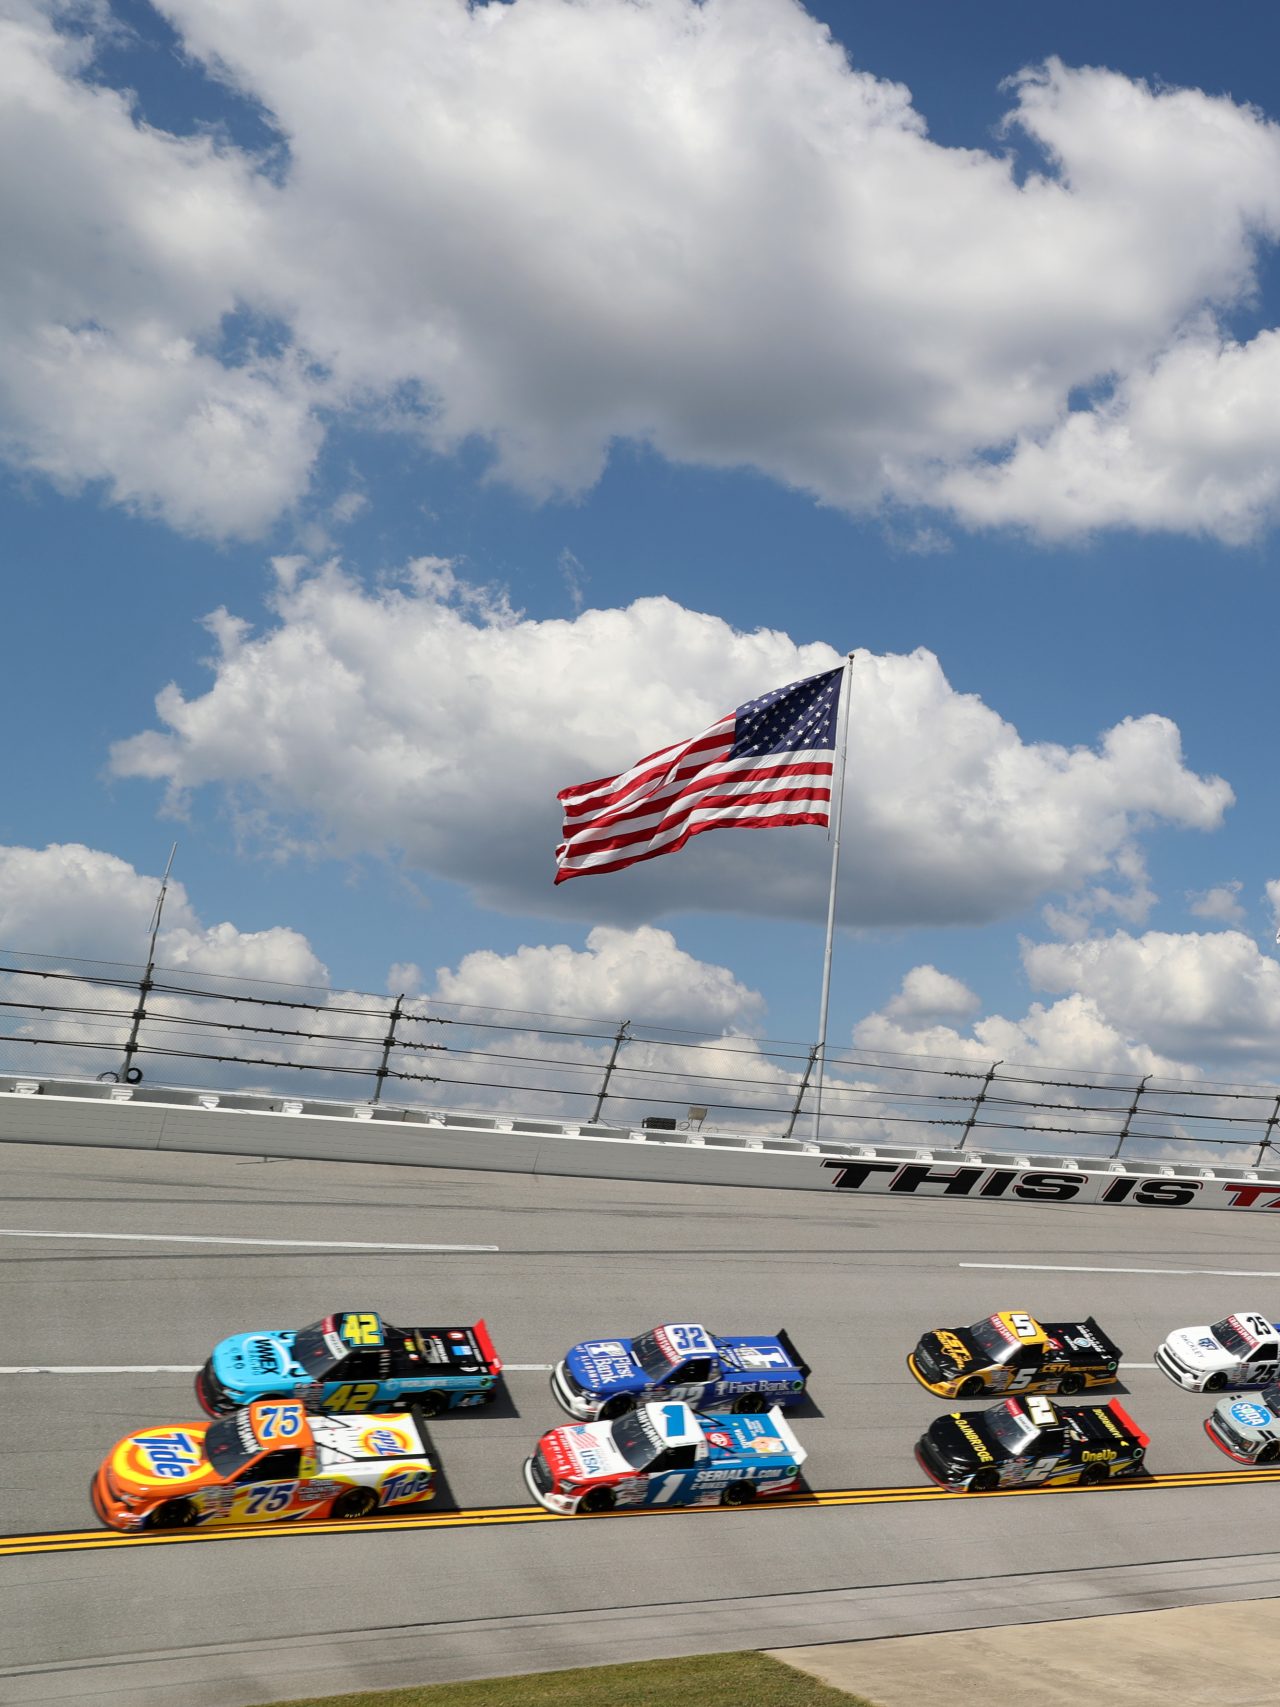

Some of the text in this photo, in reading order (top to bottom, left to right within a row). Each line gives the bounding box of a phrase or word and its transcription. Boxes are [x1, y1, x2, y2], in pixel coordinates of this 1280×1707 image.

[821, 1159, 1088, 1200] THIS
[1102, 1175, 1204, 1206] IS
[343, 1313, 383, 1346] 42
[673, 1327, 709, 1349] 32
[991, 1315, 1017, 1345] CRAFTSMAN
[1011, 1314, 1036, 1337] 5
[1228, 1316, 1257, 1348] CRAFTSMAN
[1247, 1316, 1271, 1335] 25
[254, 1339, 280, 1375] WWEX
[654, 1326, 683, 1367] CRAFTSMAN
[594, 1357, 620, 1384] Bank
[611, 1356, 635, 1378] First
[1007, 1367, 1038, 1390] 5
[1247, 1363, 1280, 1384] 25
[322, 1383, 378, 1412] 42
[728, 1381, 757, 1393] First
[758, 1380, 790, 1392] Bank
[258, 1405, 302, 1438] 75
[661, 1405, 685, 1437] 1
[1025, 1396, 1057, 1426] 2
[1236, 1403, 1265, 1426] SODA
[372, 1429, 406, 1455] Tide
[636, 1407, 665, 1452] CRAFTSMAN
[955, 1419, 994, 1463] GAINBRIDGE
[129, 1432, 200, 1478] Tide
[580, 1449, 600, 1475] USA
[1082, 1449, 1118, 1462] OneUp
[1023, 1458, 1059, 1482] 2
[245, 1484, 298, 1515] 75
[379, 1472, 430, 1507] Tide
[652, 1474, 686, 1503] 1
